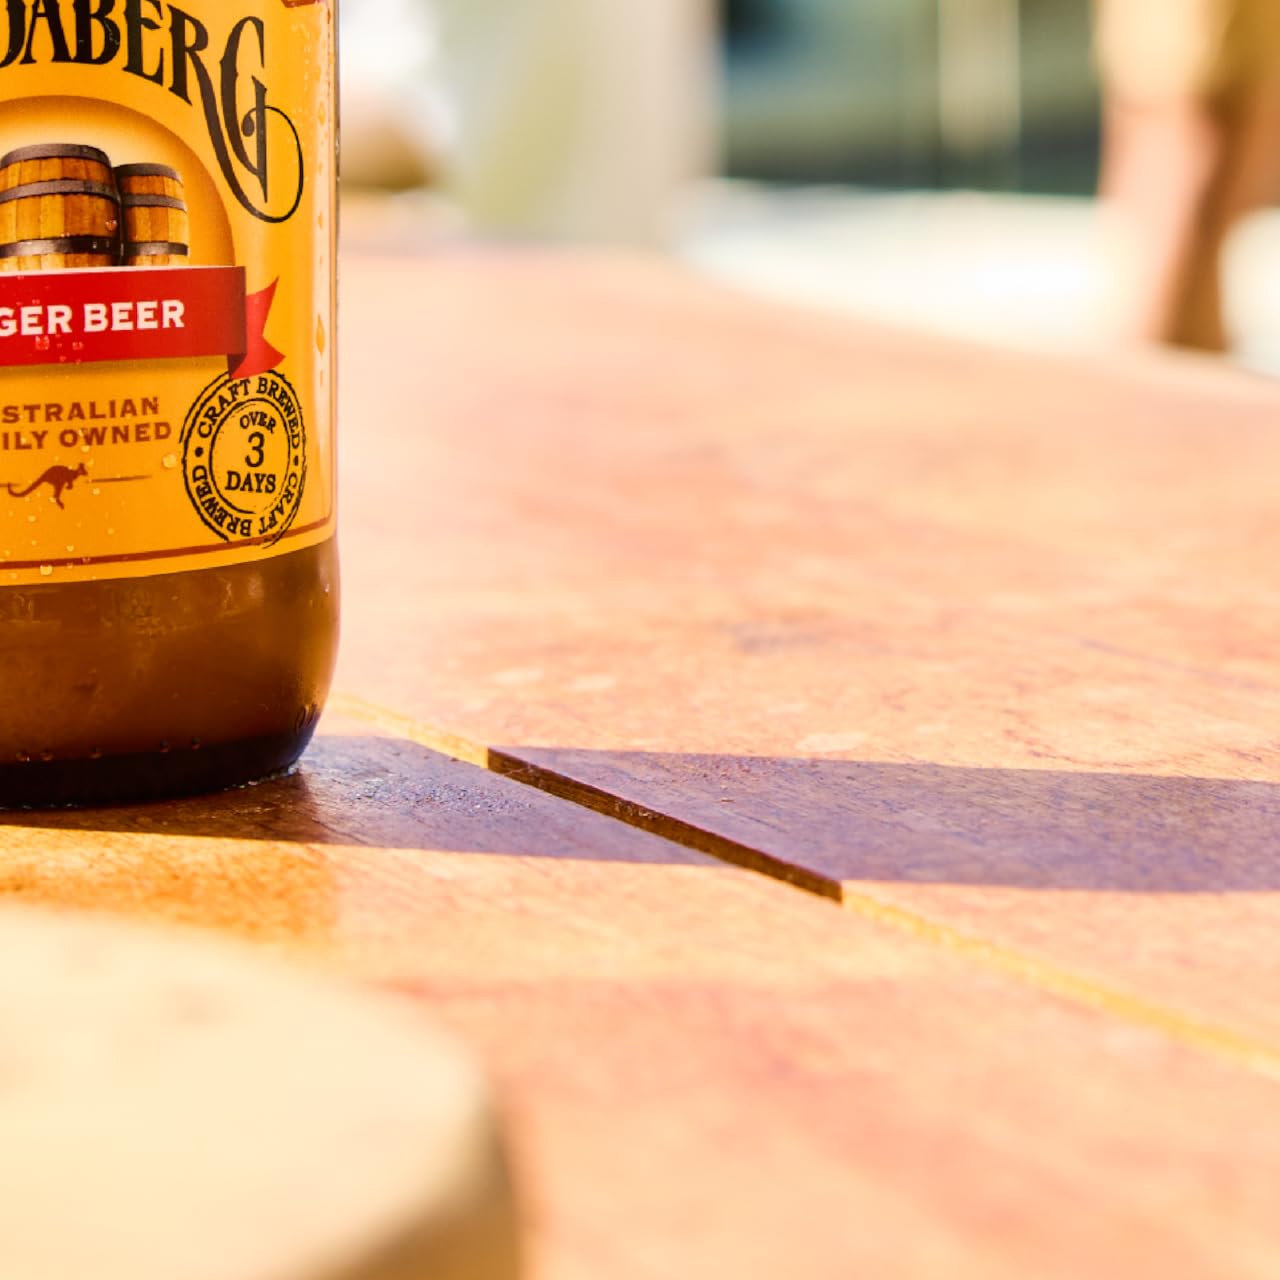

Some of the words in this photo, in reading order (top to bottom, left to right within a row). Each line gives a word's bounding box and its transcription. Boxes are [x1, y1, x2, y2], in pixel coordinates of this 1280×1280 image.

[83, 299, 186, 333] BEER
[197, 377, 251, 439] CRAFT
[256, 376, 301, 450] BREWED
[239, 411, 277, 435] OVER
[59, 421, 173, 449] OWNED
[244, 431, 266, 468] 3
[225, 470, 277, 494] DAYS
[192, 464, 252, 537] BREWED
[258, 472, 298, 535] CRAFT
